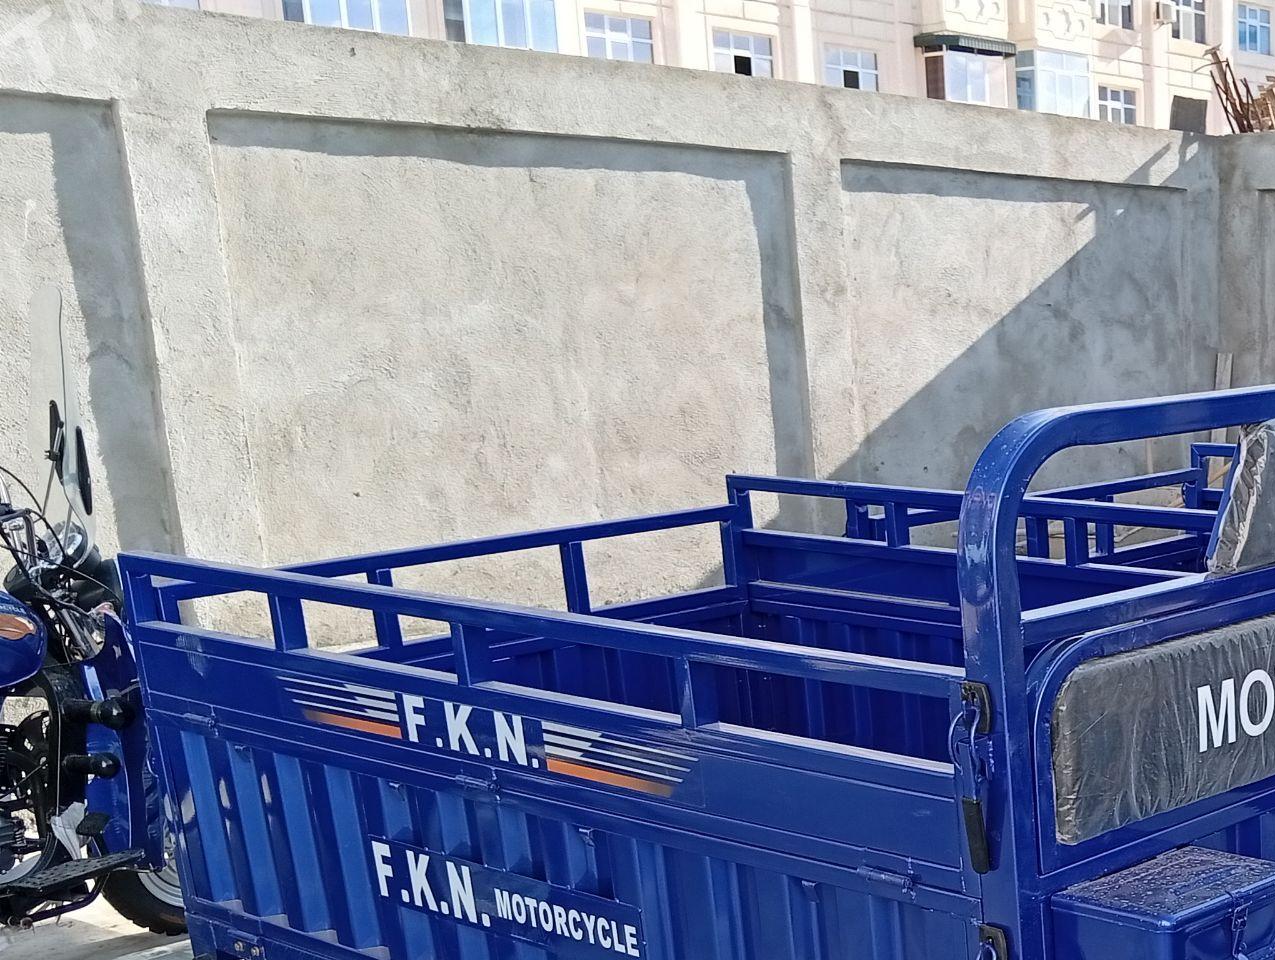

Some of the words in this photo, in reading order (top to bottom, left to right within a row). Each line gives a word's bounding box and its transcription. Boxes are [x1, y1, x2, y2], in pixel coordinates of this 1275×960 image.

[402, 693, 540, 769] F.K.N.
[371, 840, 491, 928] F.K.N.
[494, 887, 640, 958] MOTORCYCLE
